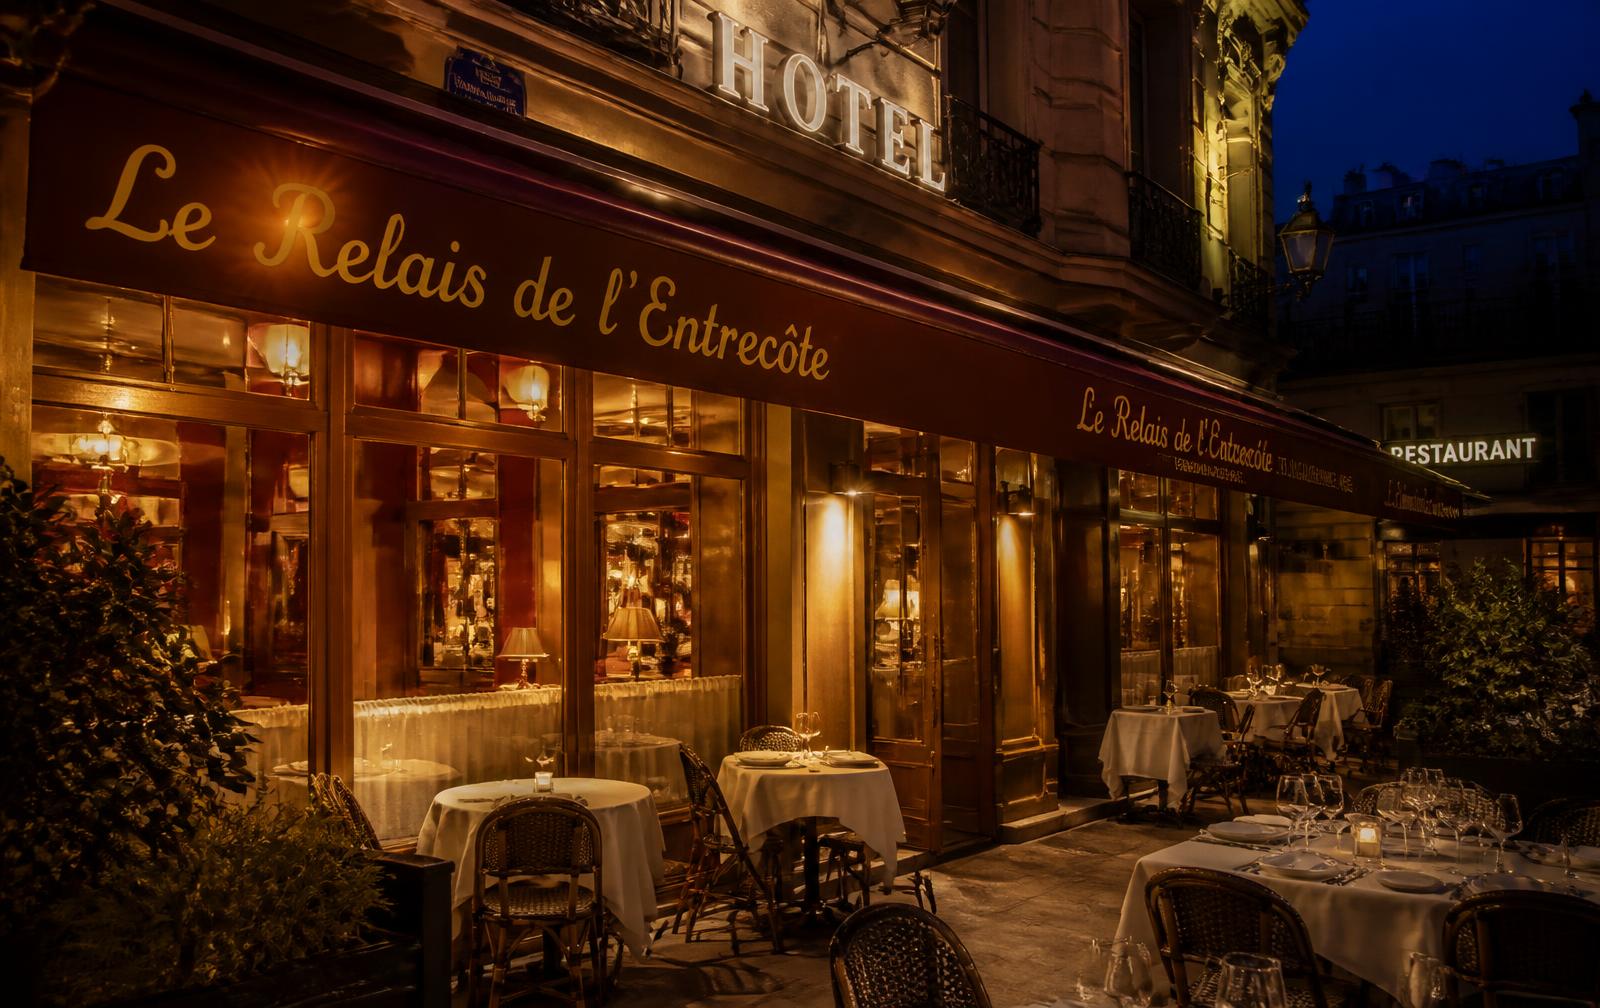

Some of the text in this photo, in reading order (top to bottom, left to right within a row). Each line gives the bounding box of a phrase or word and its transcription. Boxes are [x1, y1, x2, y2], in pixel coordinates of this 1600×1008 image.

[714, 11, 946, 192] HOTEL
[85, 144, 217, 251] Le
[253, 182, 486, 309] Relais
[512, 255, 576, 327] de
[1076, 386, 1105, 434] Le
[1111, 395, 1169, 450] Relais
[1173, 418, 1193, 454] de
